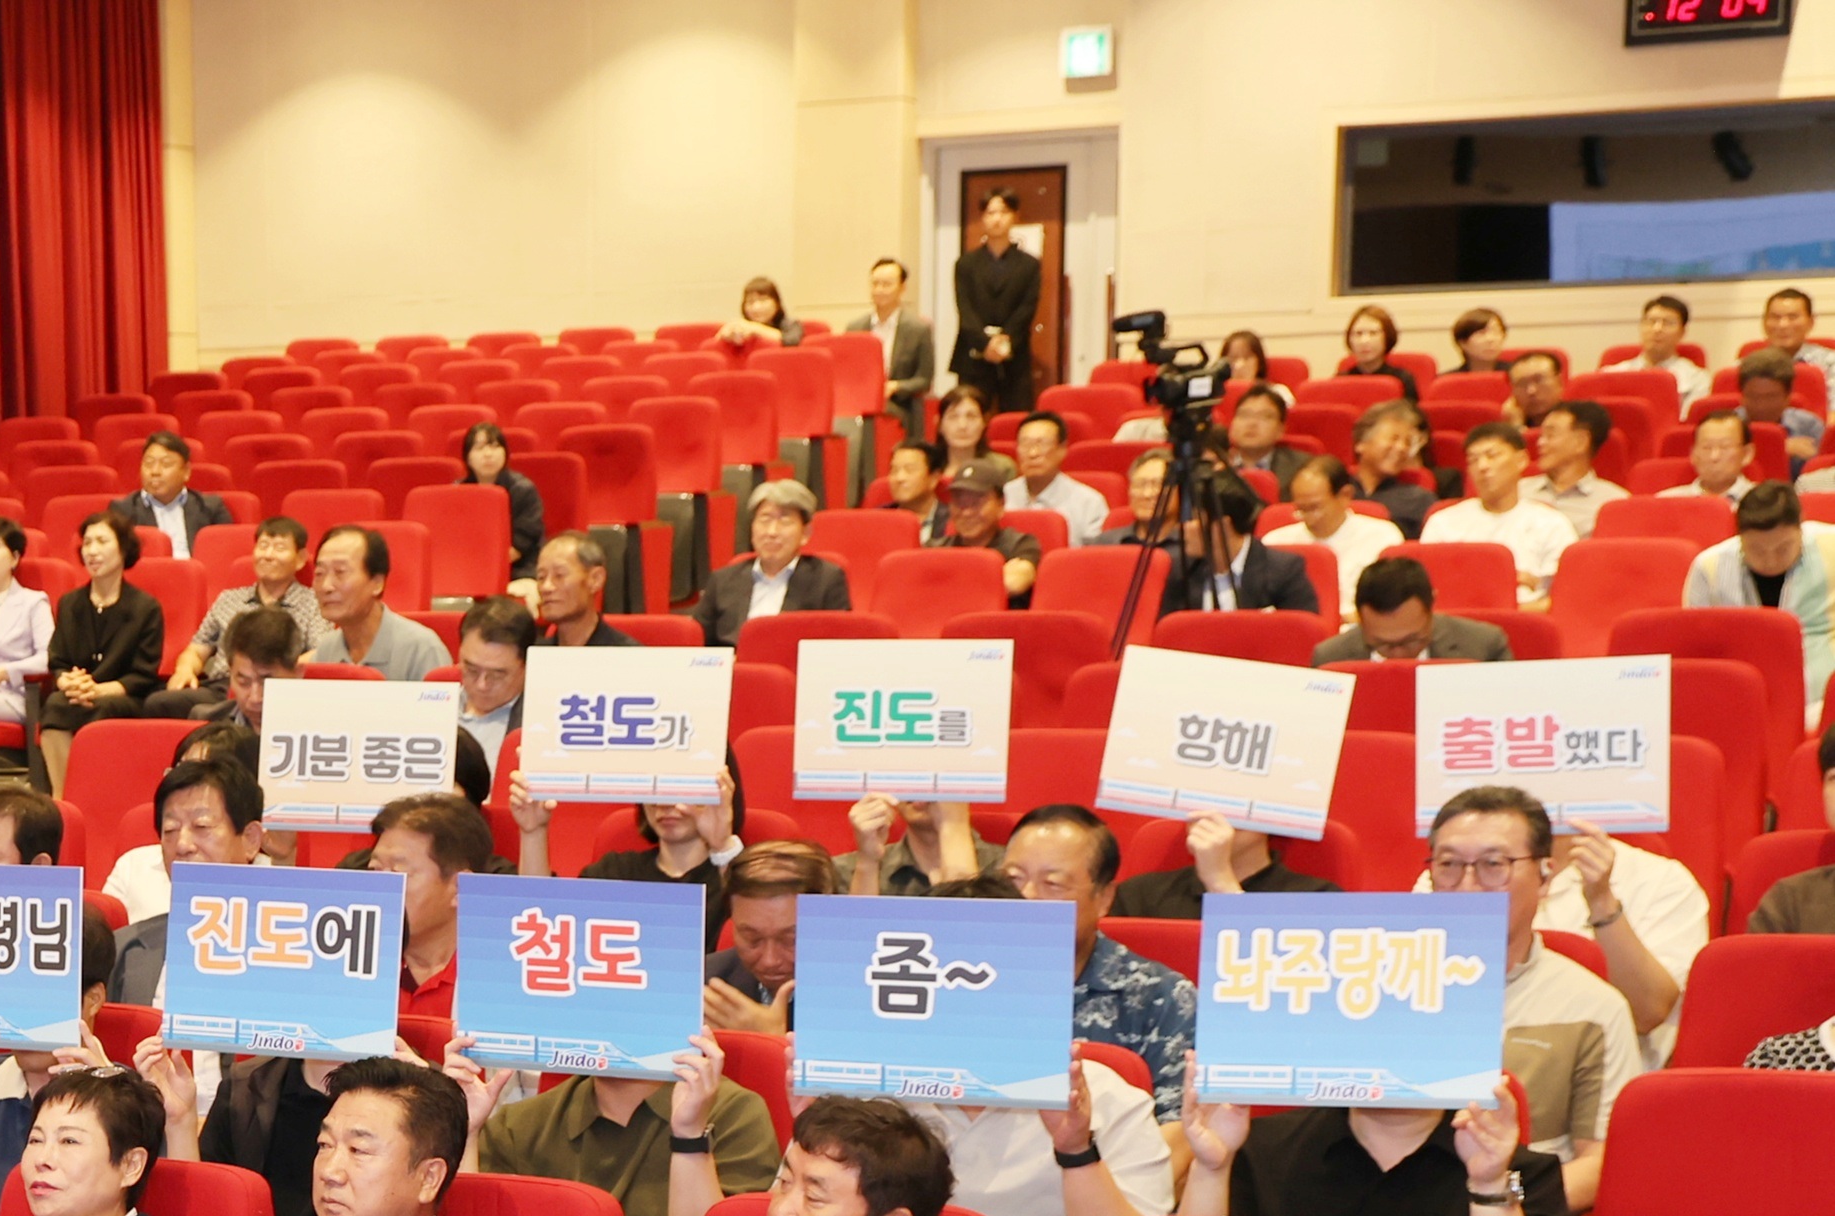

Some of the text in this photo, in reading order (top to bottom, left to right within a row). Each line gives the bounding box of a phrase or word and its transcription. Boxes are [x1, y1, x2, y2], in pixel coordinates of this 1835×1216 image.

[558, 693, 691, 748] 철도가
[832, 689, 970, 746] 진도를
[1176, 713, 1274, 772] 향해
[1441, 713, 1646, 773] 출발했다
[268, 733, 445, 782] 기분 좋은
[188, 898, 379, 979] 진도에
[512, 908, 647, 995] 철도
[868, 933, 995, 1016] 좀~
[248, 1034, 295, 1050] Jindo
[548, 1050, 597, 1069] Jindo
[897, 1079, 951, 1097] Jindo
[1308, 1082, 1368, 1100] Jindo
